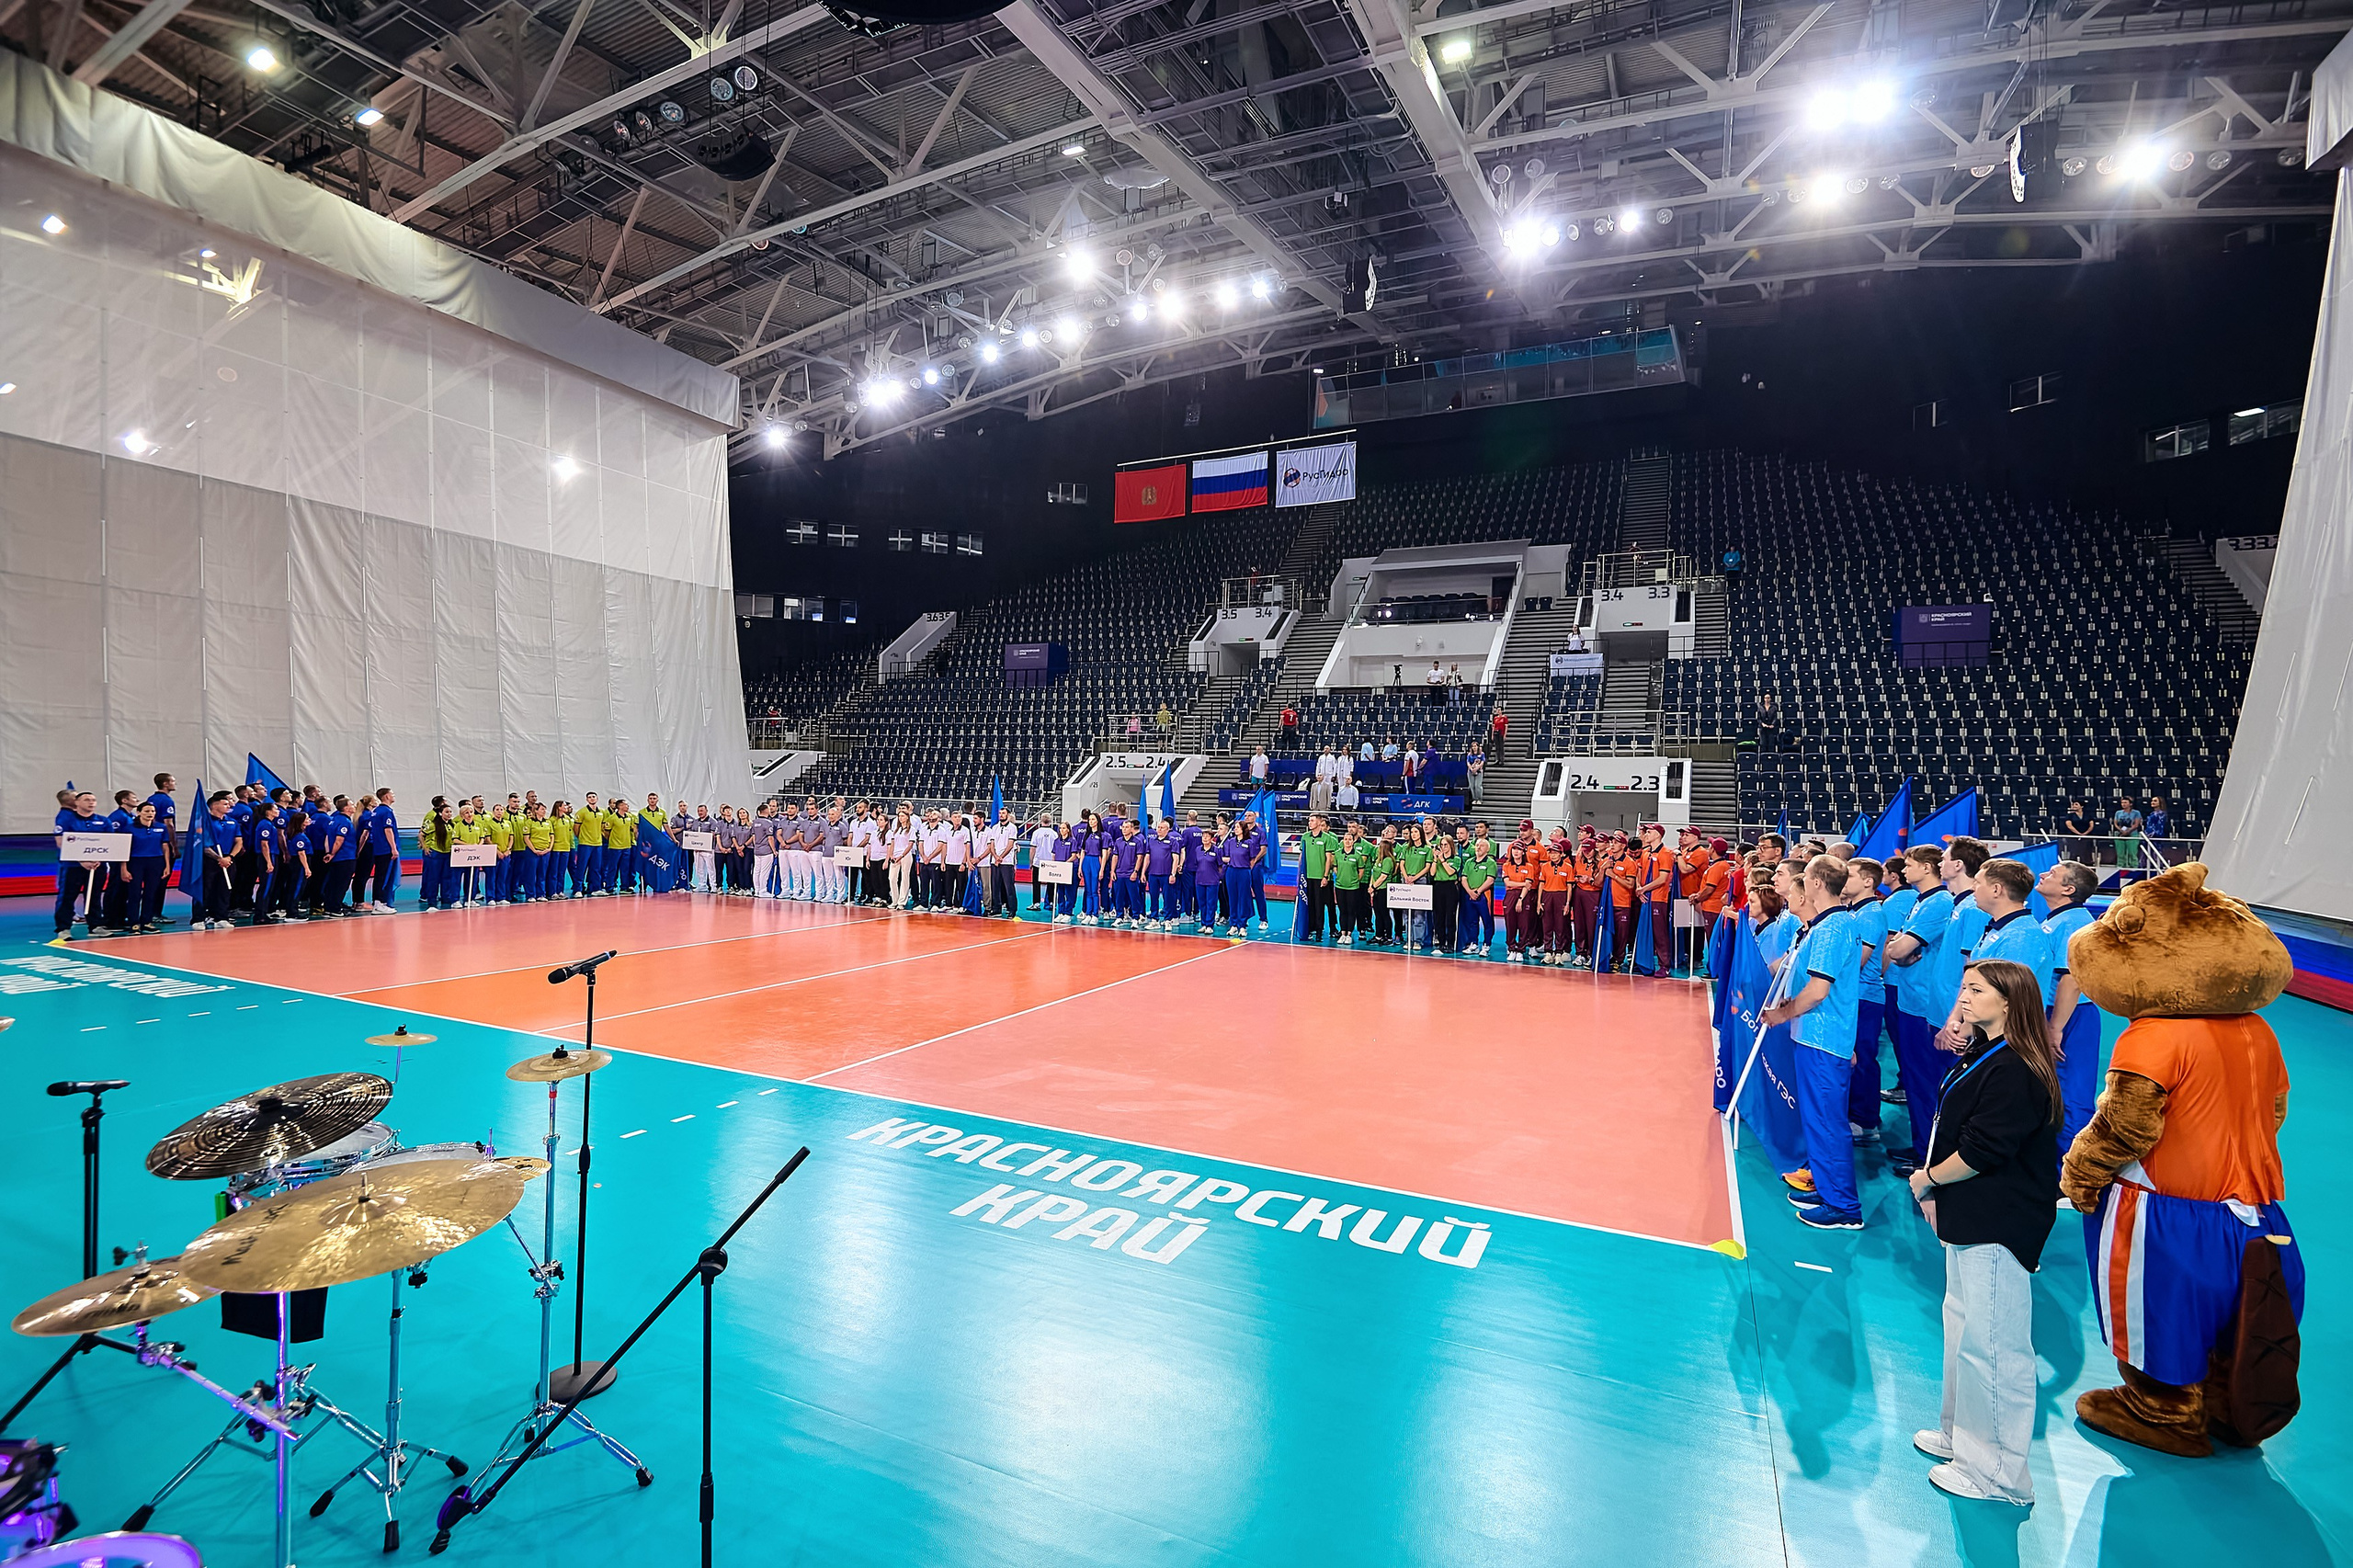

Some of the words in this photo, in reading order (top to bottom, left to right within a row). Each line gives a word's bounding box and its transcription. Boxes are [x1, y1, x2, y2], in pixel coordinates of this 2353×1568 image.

[1302, 468, 1349, 483] РусГидро
[1601, 589, 1623, 601] 3.4
[1648, 587, 1670, 598] 3.3
[1222, 608, 1237, 619] 3.5
[1255, 608, 1272, 618] 3.4
[1106, 756, 1127, 768] 2.5
[1146, 756, 1165, 768] 2.4
[1571, 774, 1599, 790] 2.4
[1631, 776, 1660, 790] 2.3
[648, 854, 670, 871] ДЭК
[1777, 1080, 1797, 1110] ГЭС
[844, 1117, 1493, 1269] КРАСНОЯРСКИЙ
[949, 1183, 1212, 1266] КРАЙ
